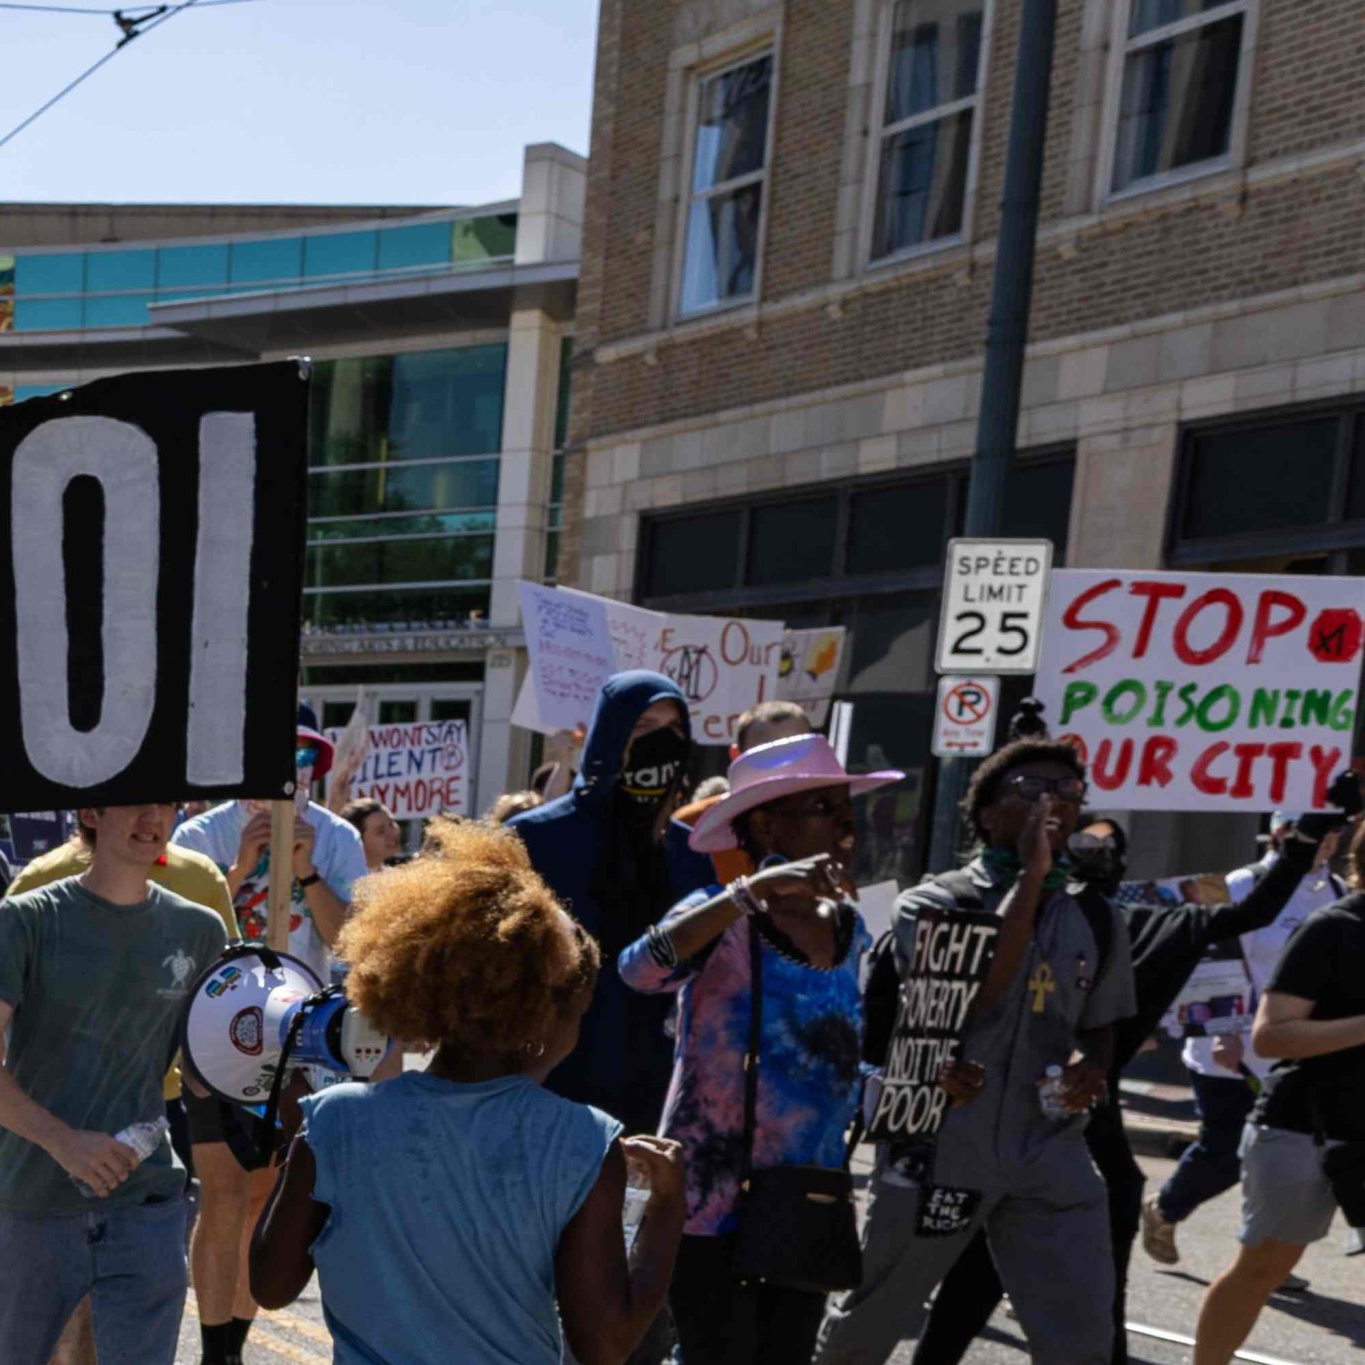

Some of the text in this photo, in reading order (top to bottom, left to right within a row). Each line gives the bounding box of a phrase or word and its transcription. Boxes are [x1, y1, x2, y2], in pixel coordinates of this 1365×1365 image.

[957, 556, 1040, 576] SPEED
[963, 584, 1027, 602] LIMIT
[720, 621, 780, 666] Our
[950, 611, 1029, 655] 25
[1061, 578, 1307, 673] STOP
[1059, 678, 1355, 733] POISONING
[369, 724, 424, 749] WONT
[350, 747, 444, 784] ILENT
[1190, 740, 1342, 808] CITY
[358, 775, 461, 814] NYMORE
[911, 920, 997, 975] FIGHT
[900, 978, 981, 1031] POVERTY
[887, 1037, 926, 1083] NOT
[870, 1085, 947, 1134] POOR
